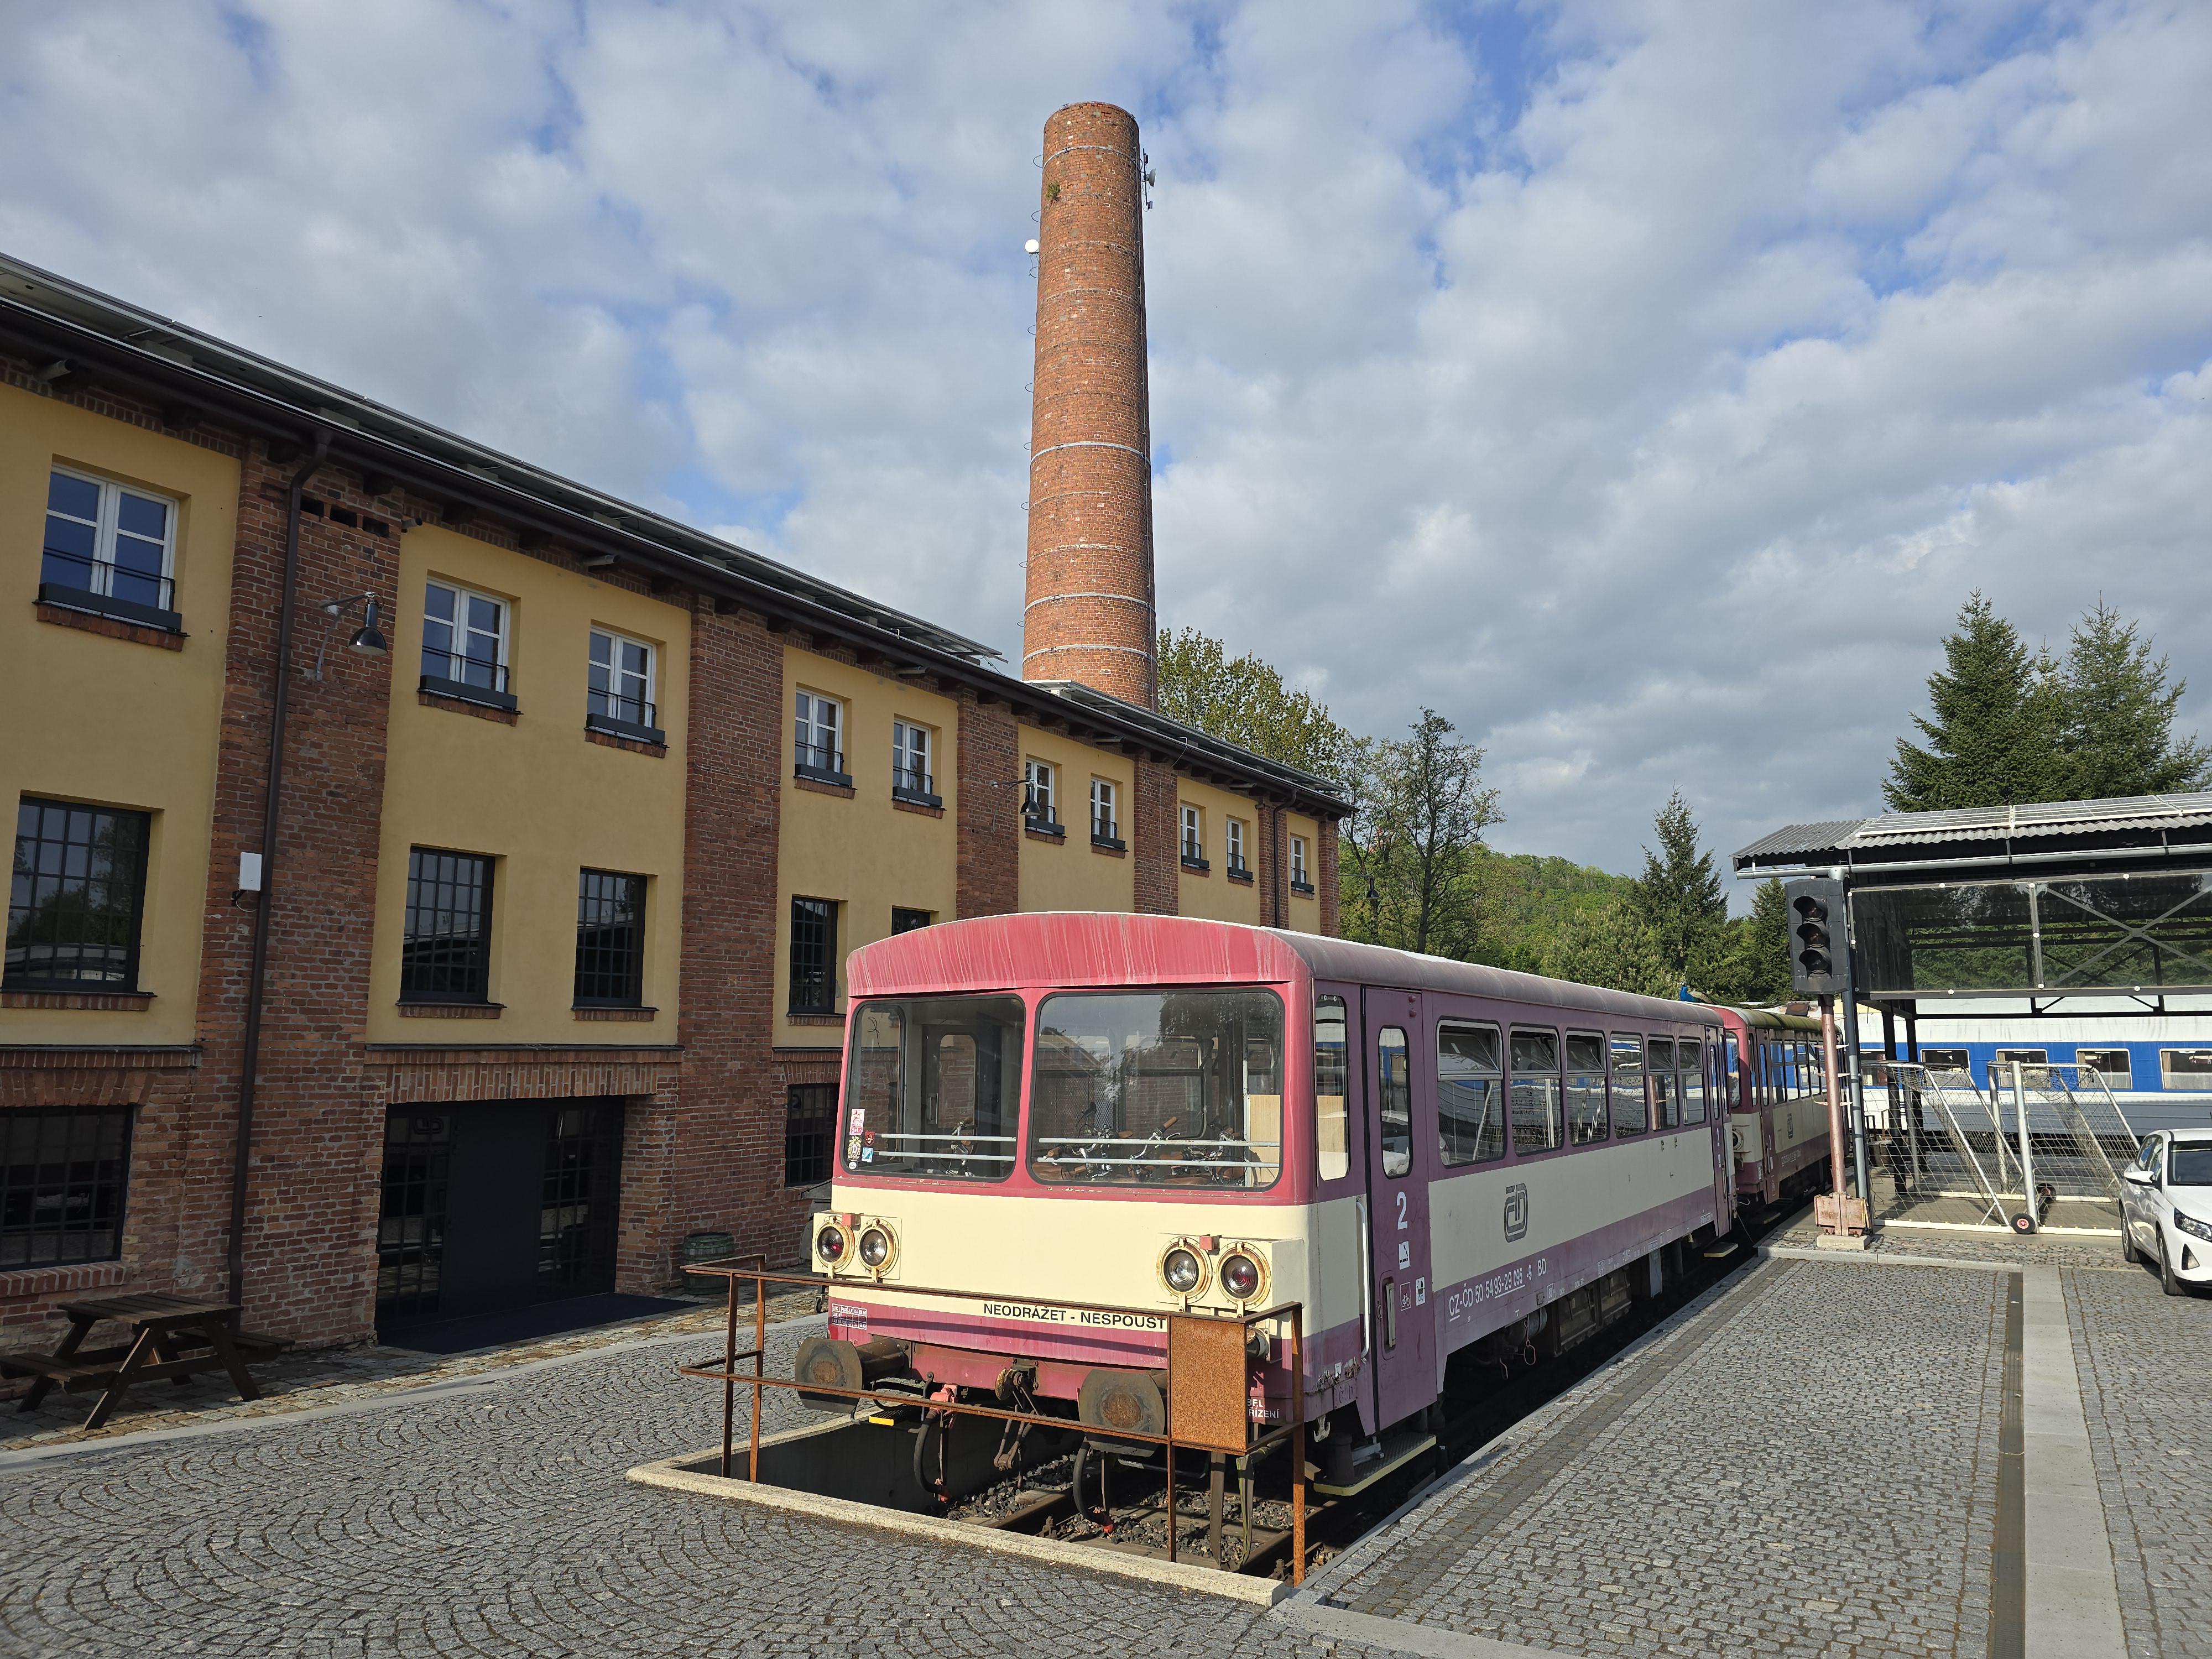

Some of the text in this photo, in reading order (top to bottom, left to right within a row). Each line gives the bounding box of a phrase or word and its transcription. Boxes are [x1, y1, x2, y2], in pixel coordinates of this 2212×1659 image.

[1717, 1128, 1720, 1146] 2
[1396, 1191, 1408, 1230] 2
[1449, 1282, 1473, 1316] CZ-ČD
[1475, 1284, 1483, 1303] 50
[1537, 1258, 1546, 1276] BD
[984, 1303, 1066, 1322] NEODRÁŽET
[1081, 1312, 1166, 1329] NESPOUST
[1247, 1399, 1264, 1407] BEL
[1249, 1406, 1280, 1418] ŘÍZENÍ
